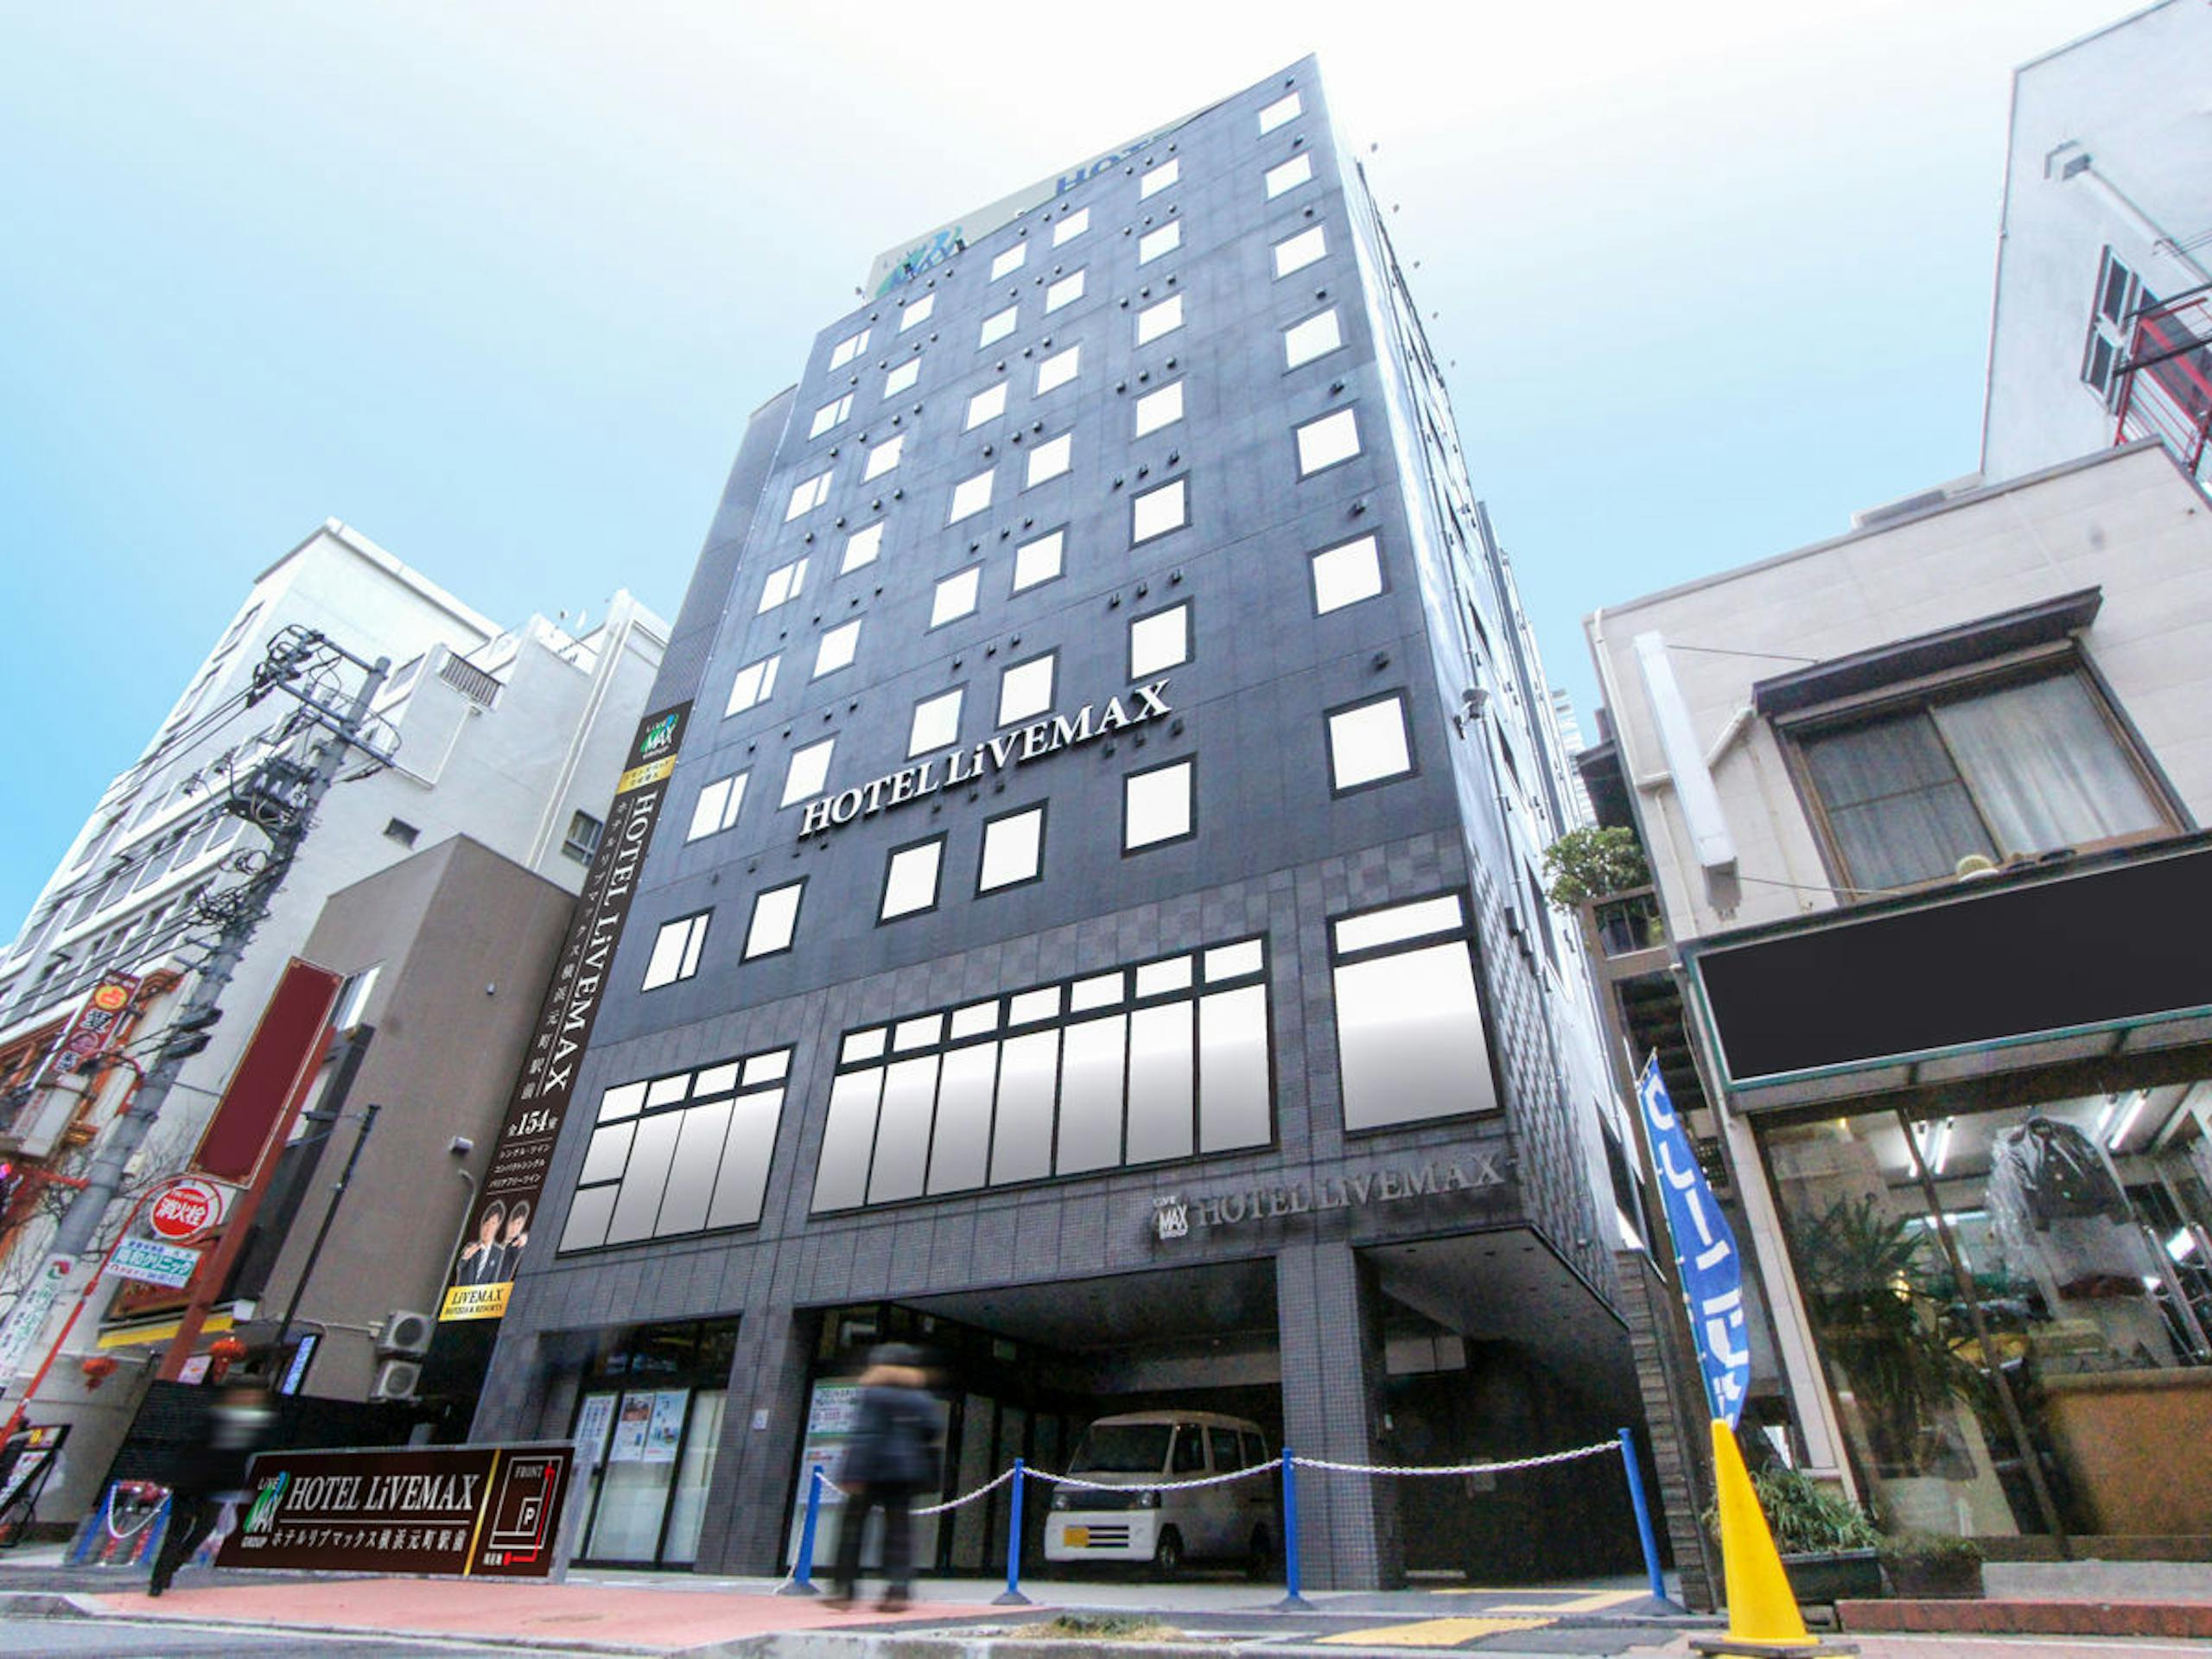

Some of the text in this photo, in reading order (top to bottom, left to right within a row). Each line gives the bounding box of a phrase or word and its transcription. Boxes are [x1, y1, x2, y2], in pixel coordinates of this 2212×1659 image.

[798, 760, 938, 837] HOTEL
[602, 791, 658, 907] HOTEL
[156, 1198, 206, 1226] 消火栓
[1197, 1186, 1312, 1228] HOTEL
[284, 1477, 362, 1511] HOTEL
[523, 1507, 536, 1525] P
